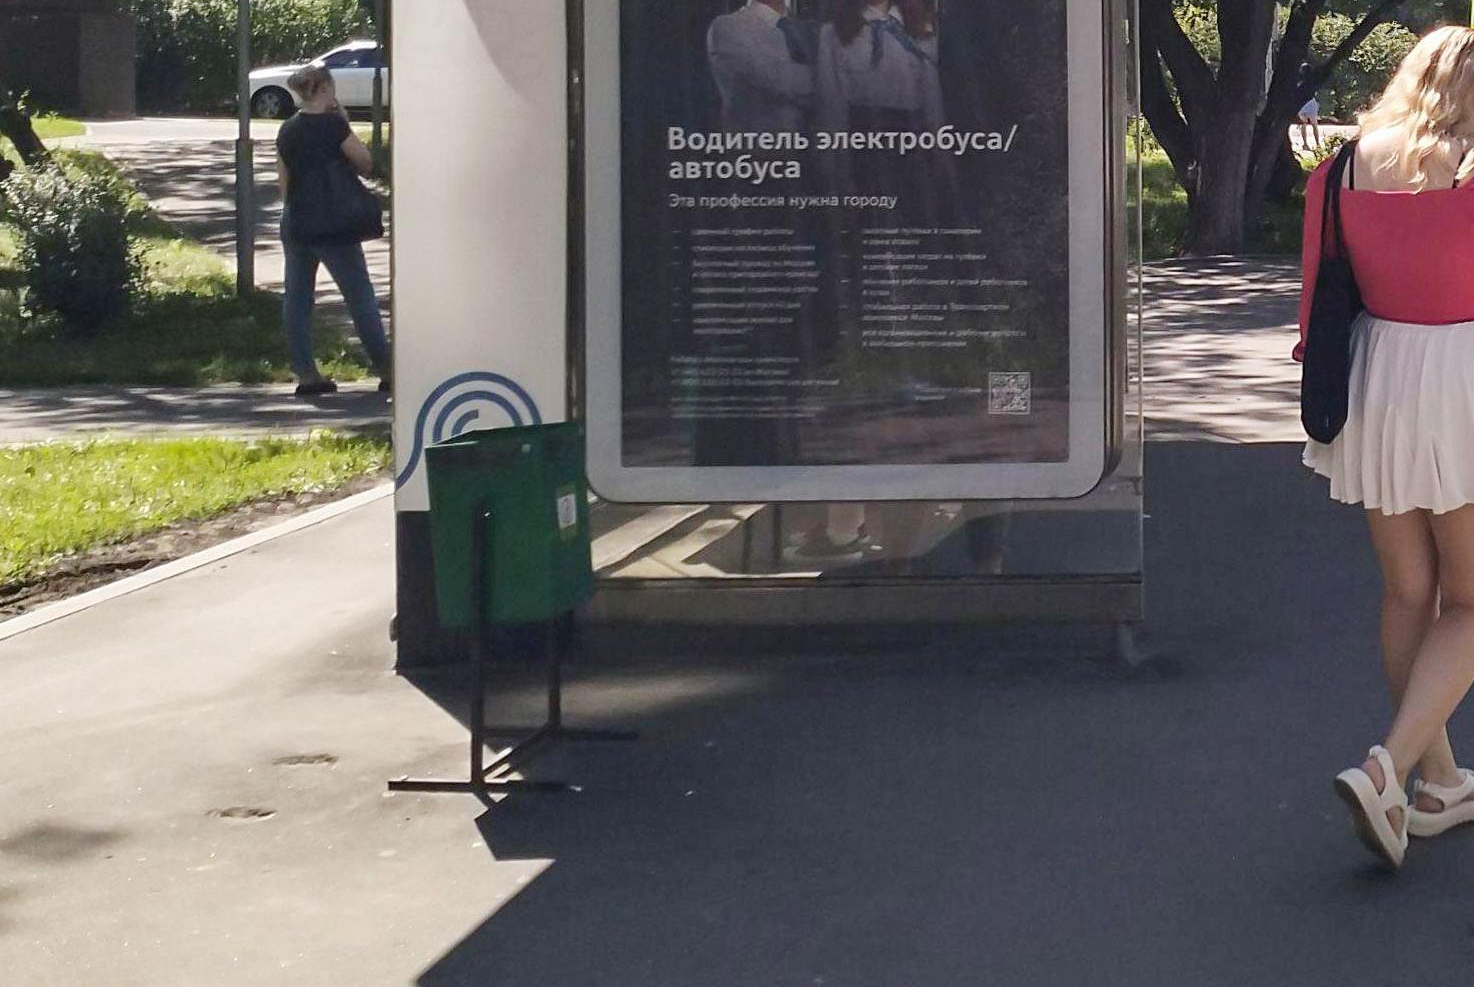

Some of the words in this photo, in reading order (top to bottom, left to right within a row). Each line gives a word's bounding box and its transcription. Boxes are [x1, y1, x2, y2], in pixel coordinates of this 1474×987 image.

[668, 126, 809, 154] Водитель
[816, 124, 1018, 155] электробуса/
[669, 154, 801, 185] автобуса
[669, 193, 696, 208] Эта
[699, 193, 785, 209] профессия
[789, 196, 839, 209] нужна
[843, 195, 898, 210] городу
